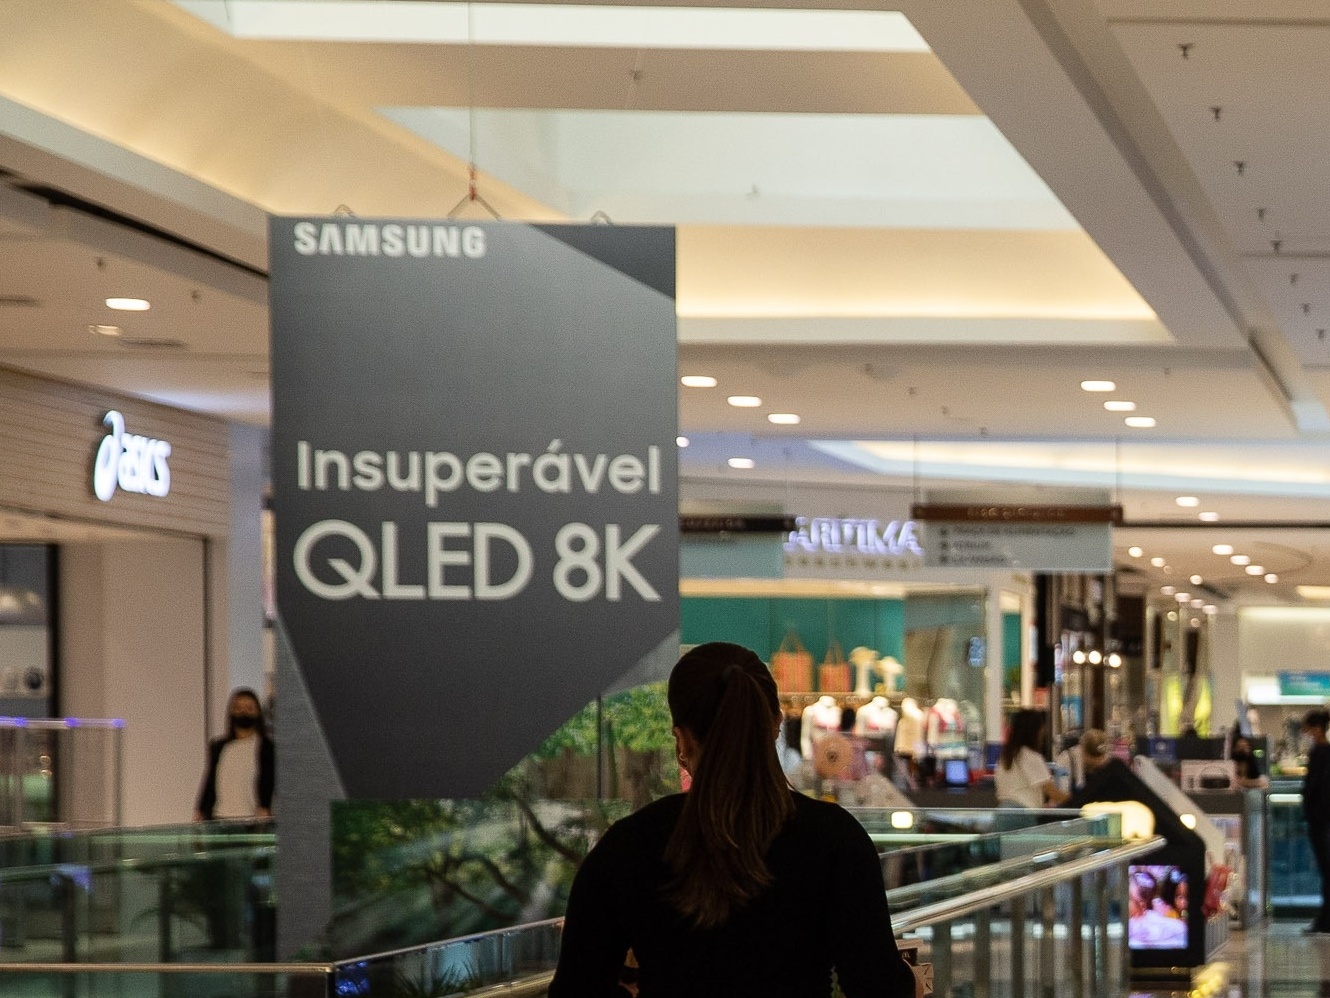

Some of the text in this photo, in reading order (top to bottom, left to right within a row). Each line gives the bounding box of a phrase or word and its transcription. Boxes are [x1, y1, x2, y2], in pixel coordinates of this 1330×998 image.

[294, 221, 487, 258] SAMSUNG
[297, 439, 661, 507] Insuperável
[293, 518, 661, 601] QLED 8K
